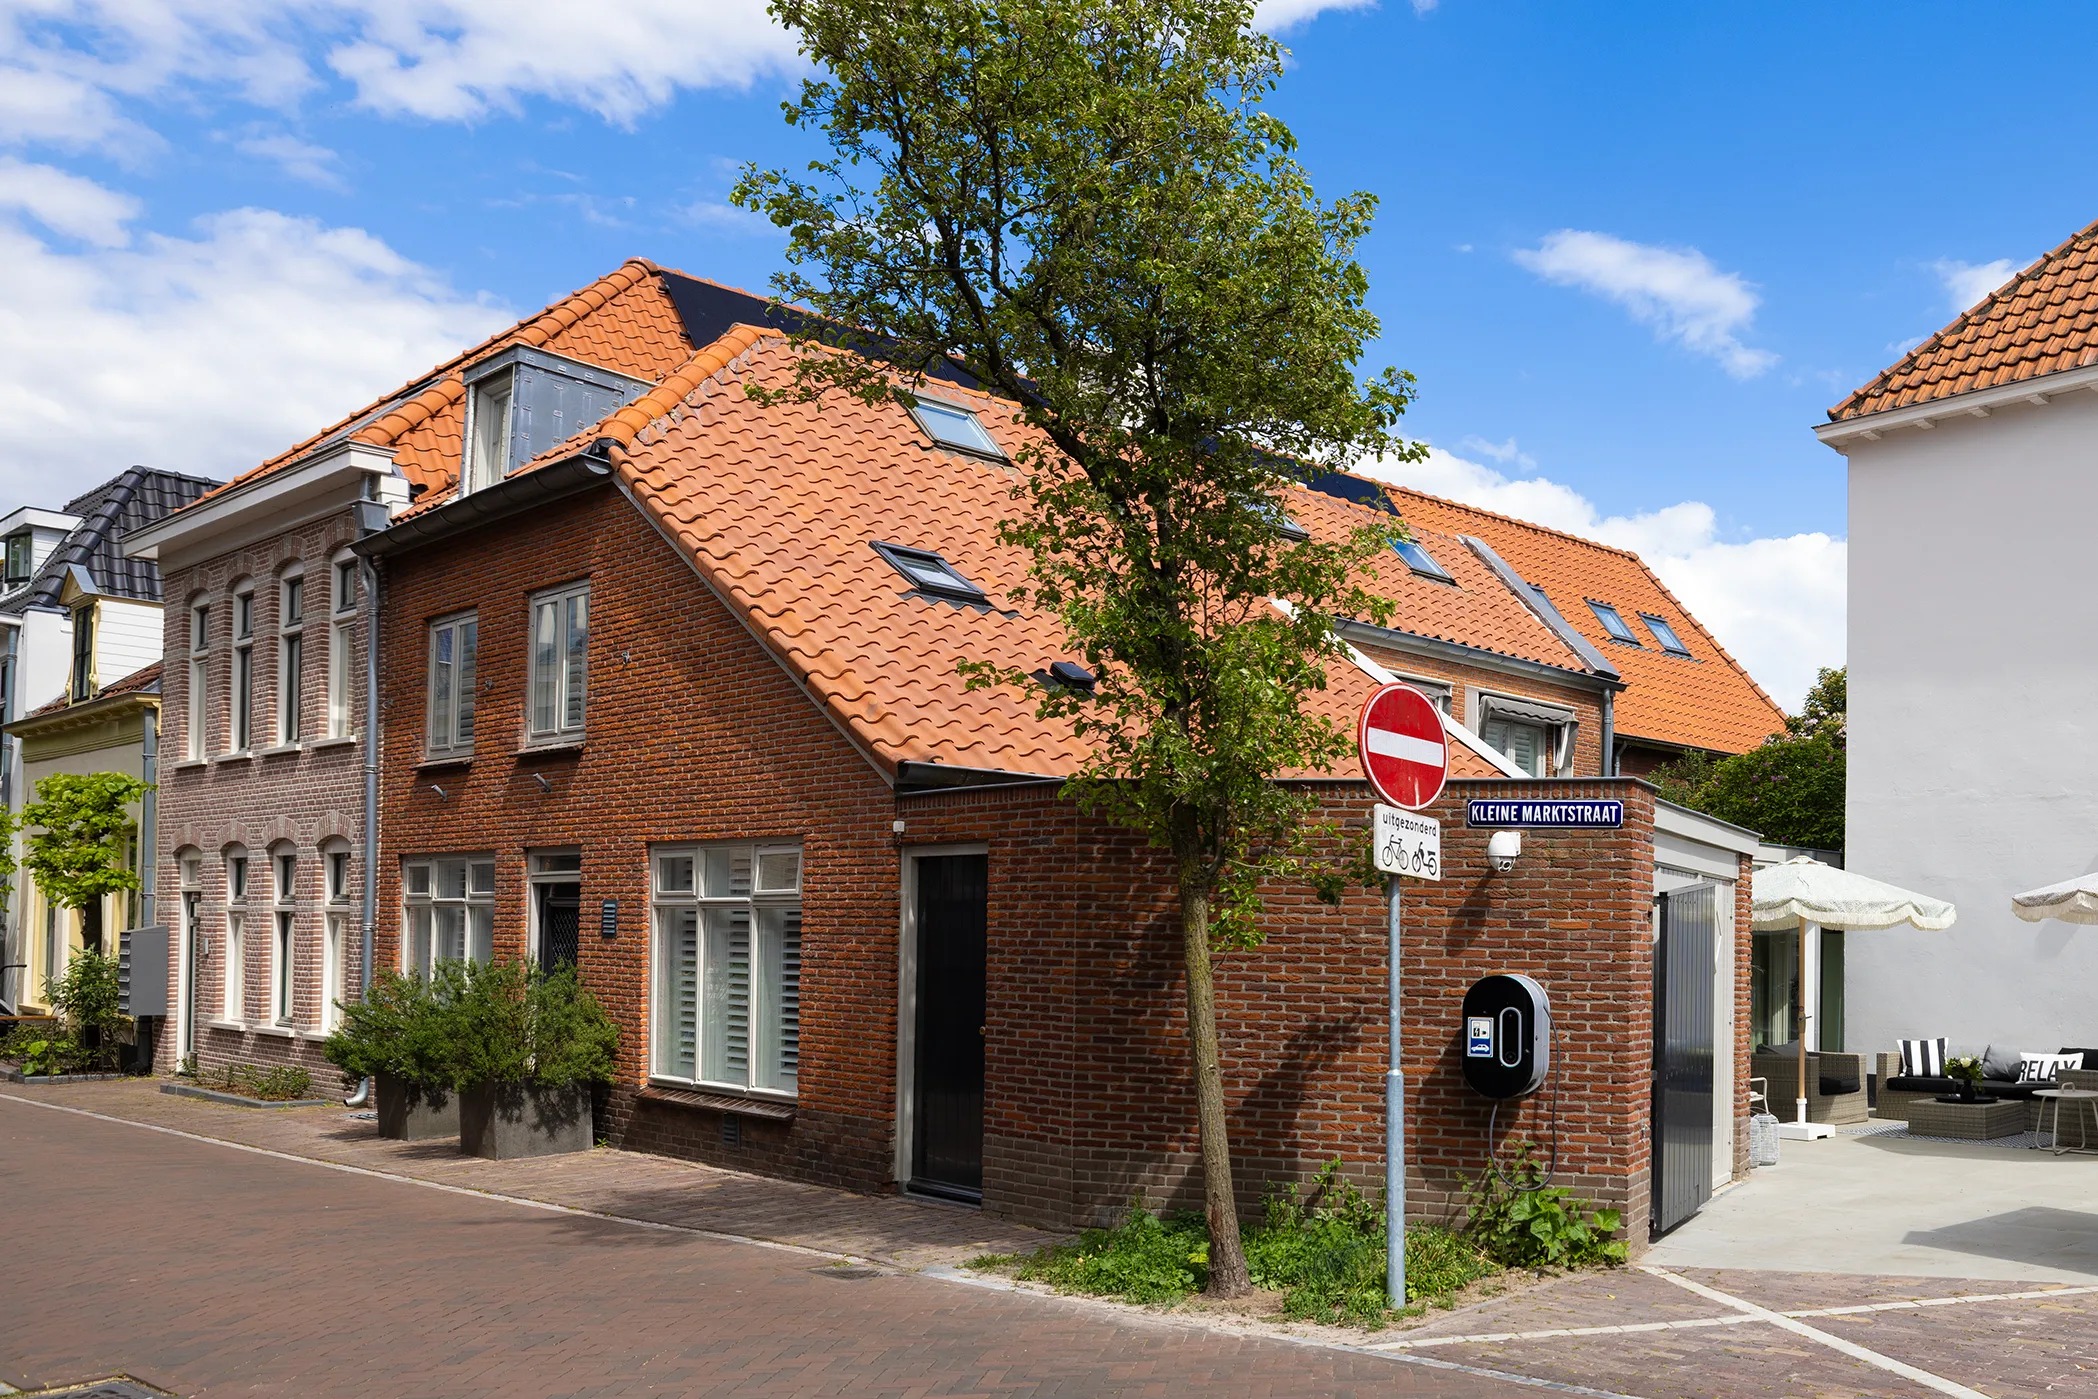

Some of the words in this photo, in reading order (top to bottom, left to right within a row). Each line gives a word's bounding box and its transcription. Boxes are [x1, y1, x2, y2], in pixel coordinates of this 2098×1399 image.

[1471, 805, 1519, 821] KLEINE
[1522, 805, 1619, 822] MARKTSTRAAT
[1382, 812, 1437, 837] uitgezonderd
